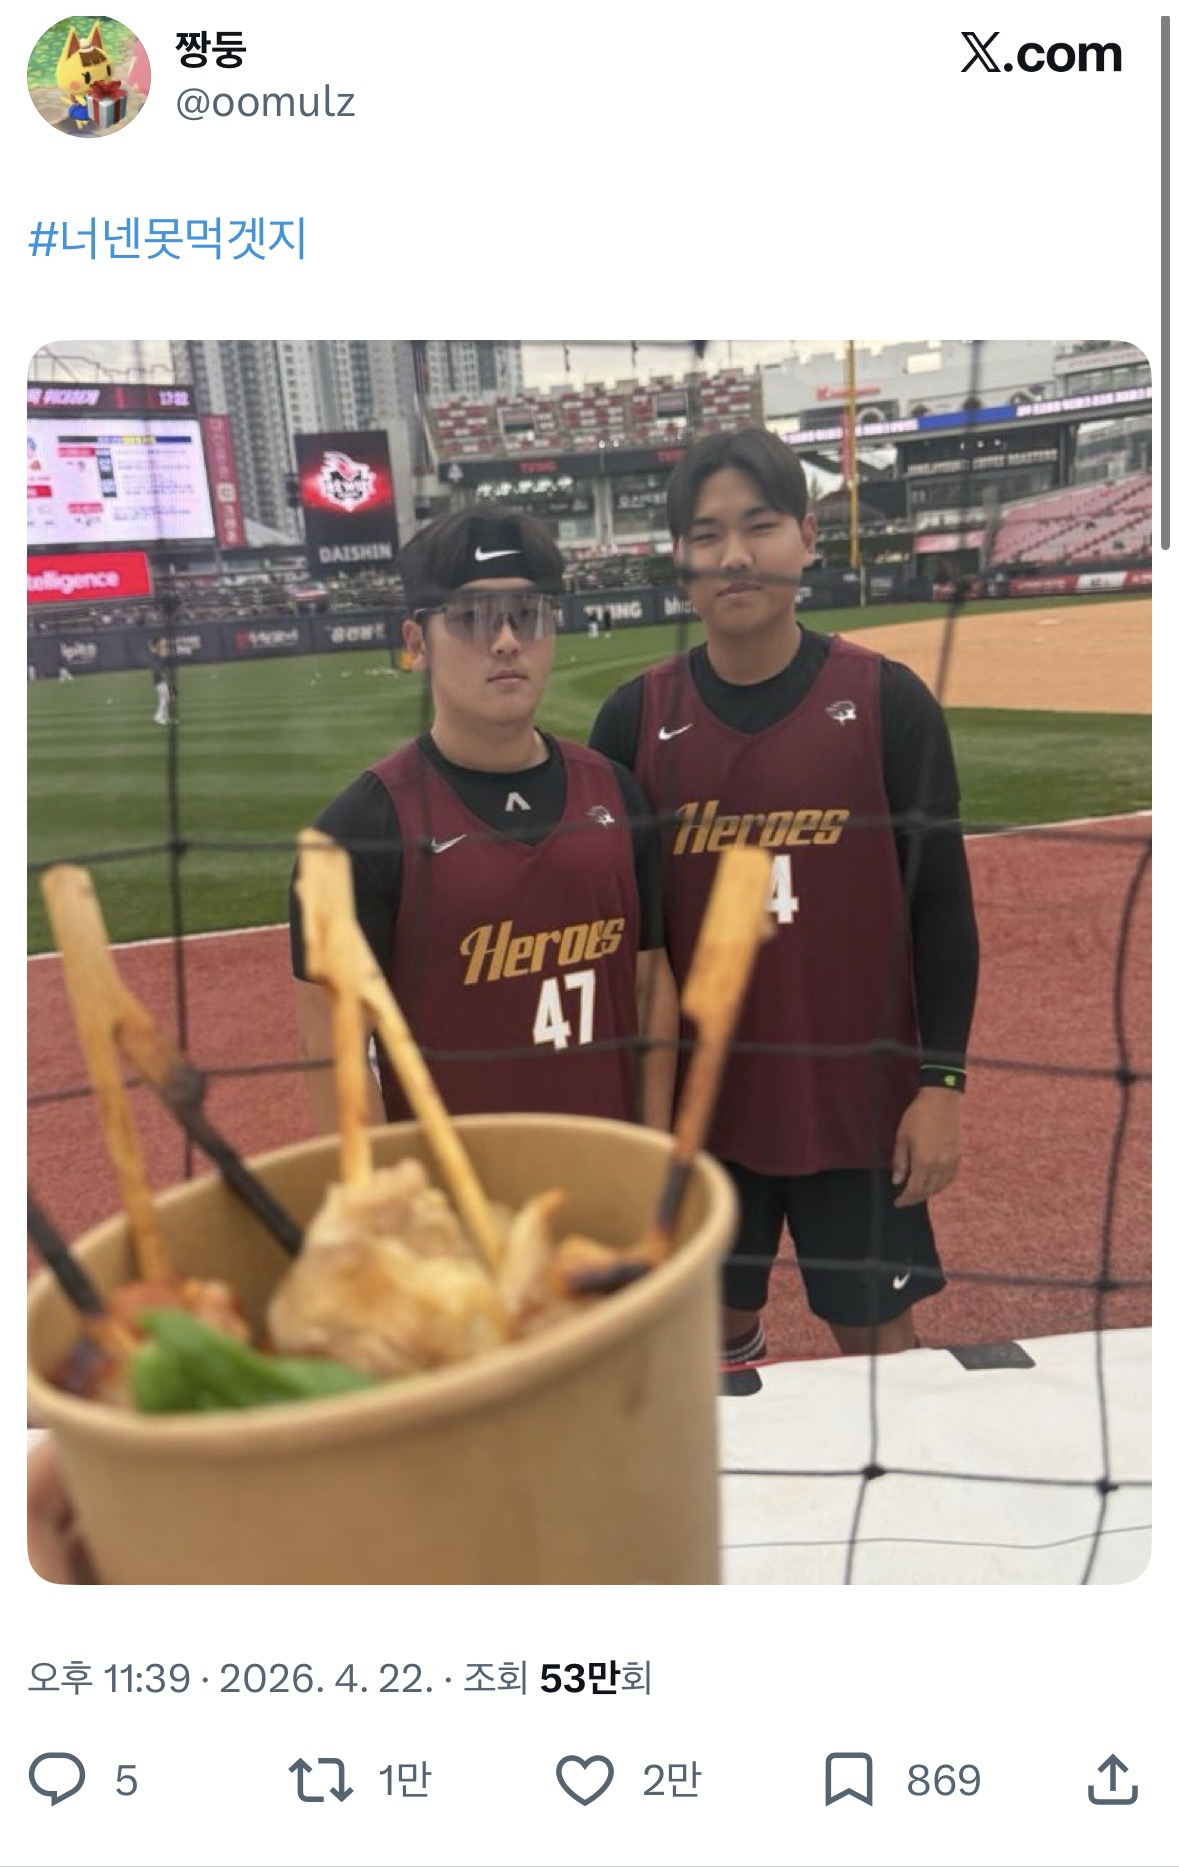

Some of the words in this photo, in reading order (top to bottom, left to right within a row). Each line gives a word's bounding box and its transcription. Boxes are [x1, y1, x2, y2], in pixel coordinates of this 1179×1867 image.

[319, 542, 392, 563] DAISHIN
[673, 800, 849, 856] Heroes
[459, 917, 625, 985] Heroes
[533, 969, 596, 1050] 47
